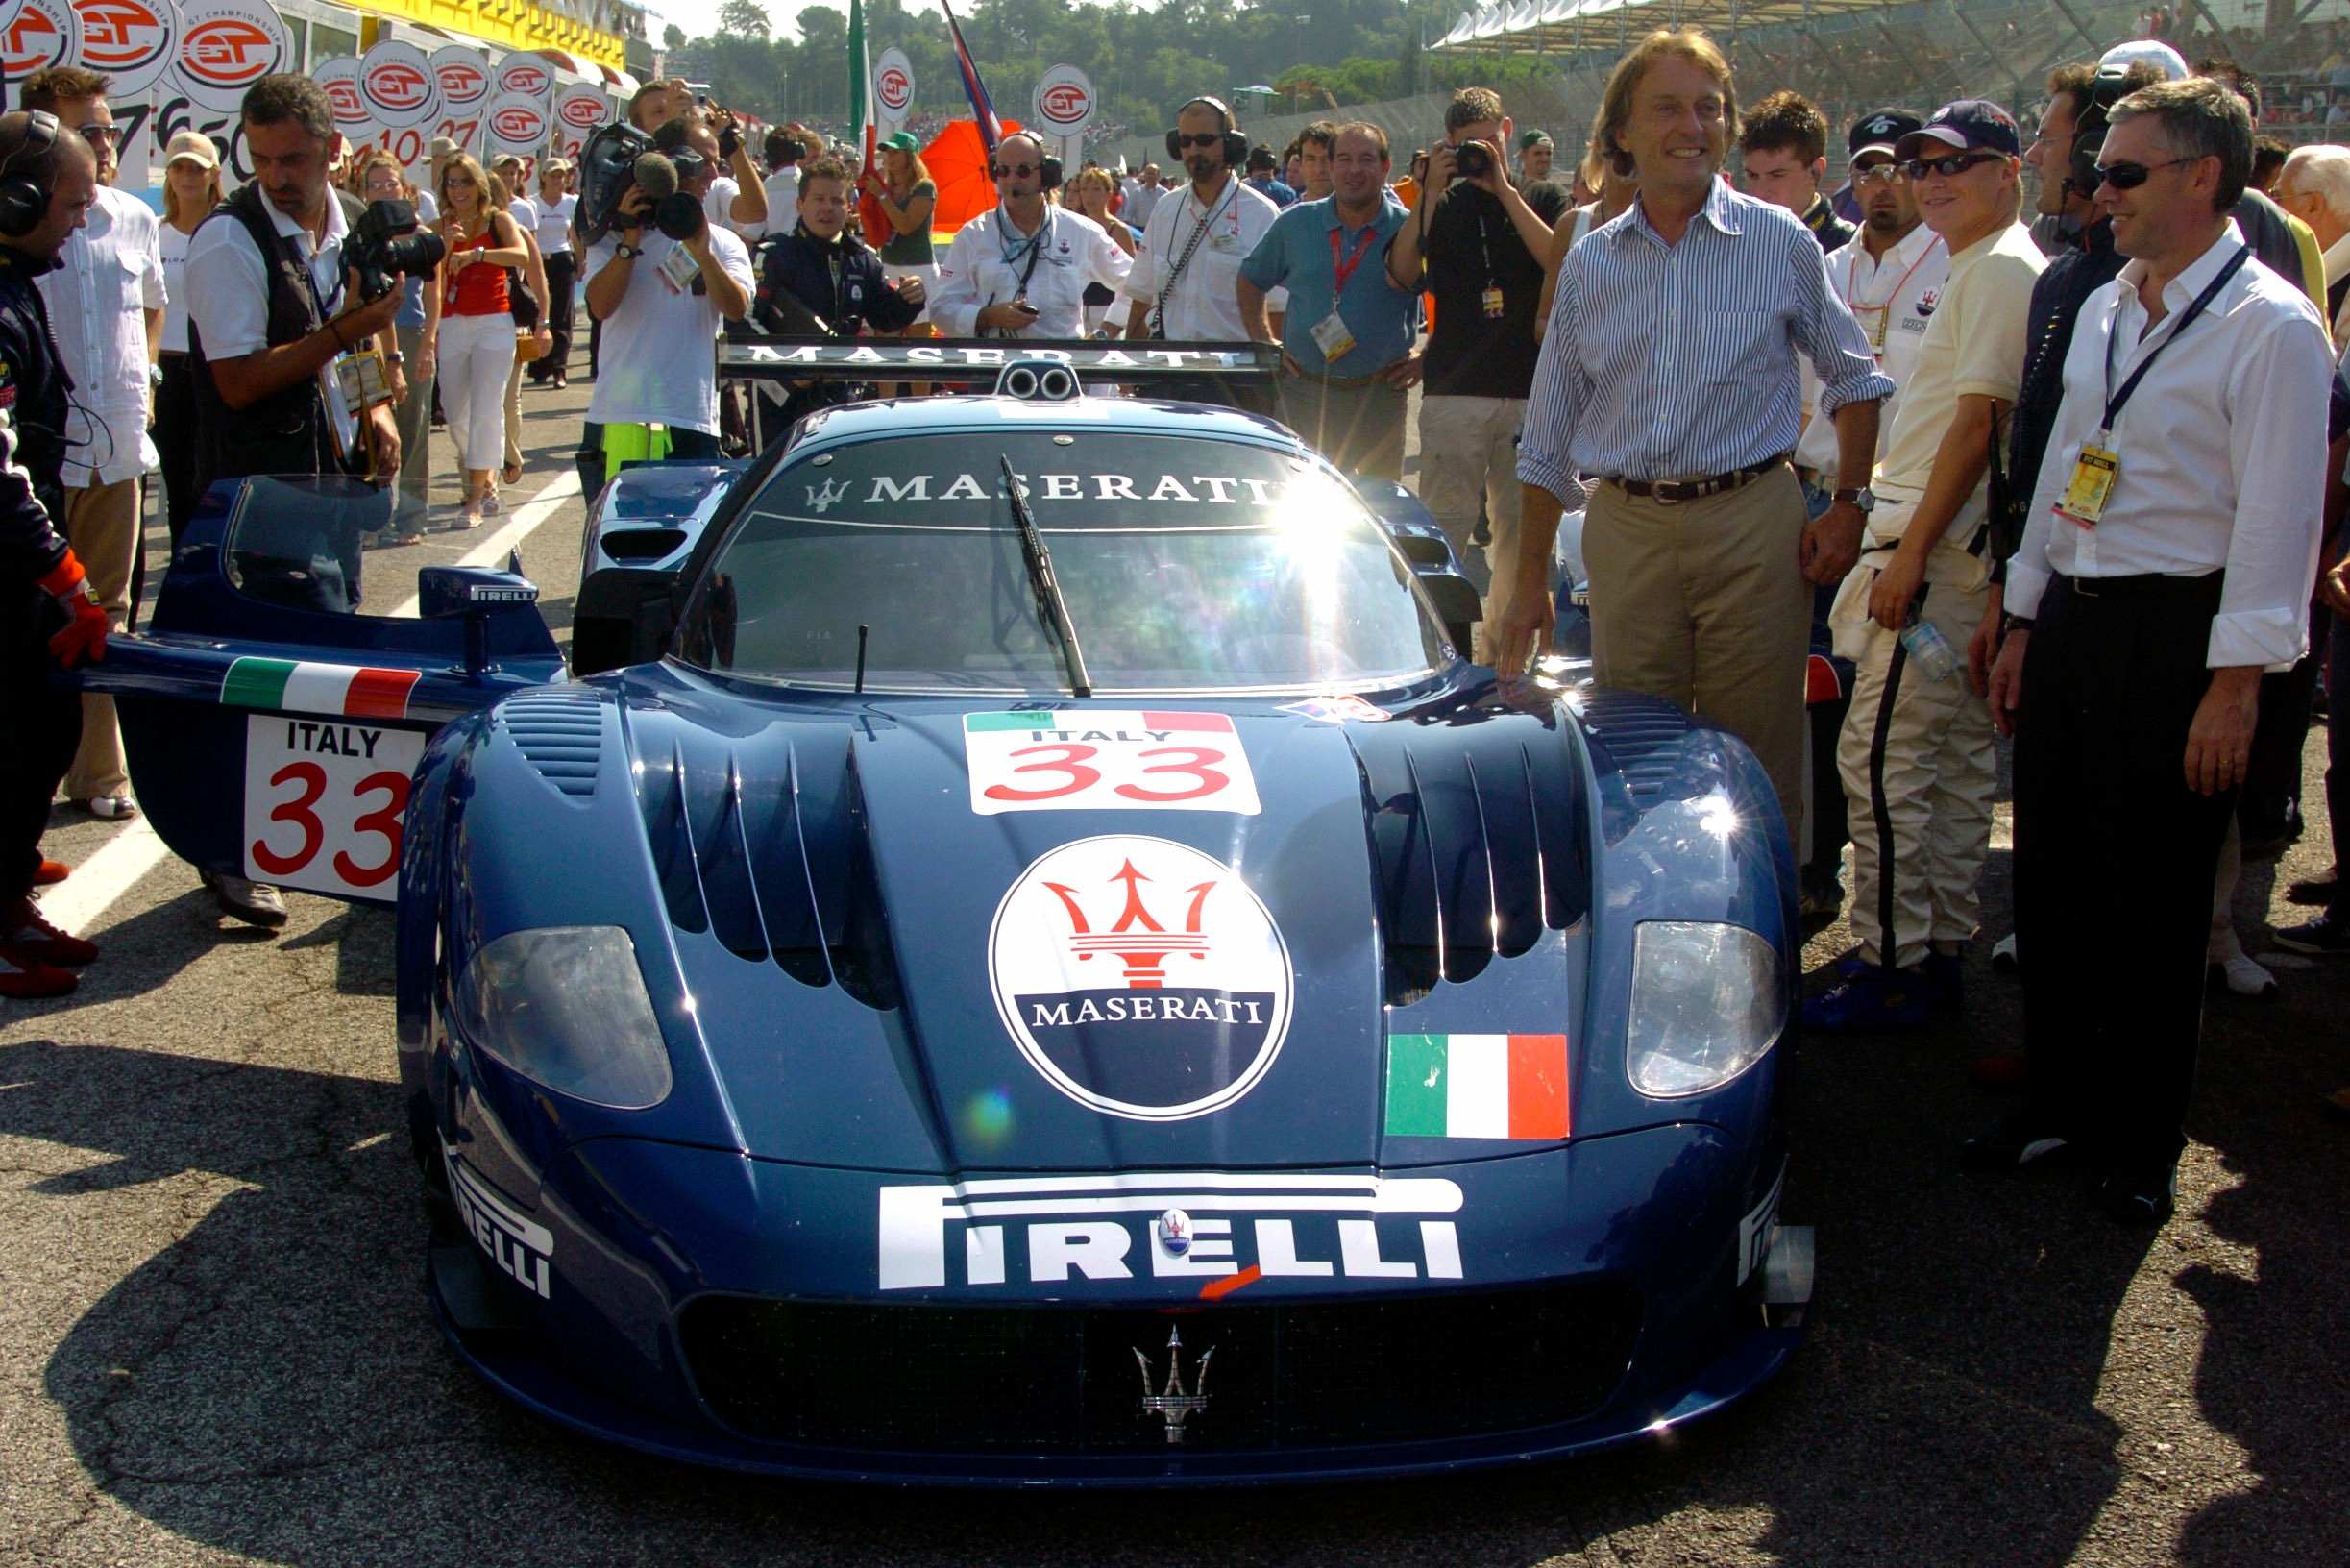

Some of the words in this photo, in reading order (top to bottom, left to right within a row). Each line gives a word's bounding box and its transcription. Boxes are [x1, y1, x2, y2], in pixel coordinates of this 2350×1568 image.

[206, 10, 282, 44] CHAMPIONSHIP
[197, 34, 273, 64] GT
[379, 73, 427, 96] GT
[440, 73, 483, 90] GT
[510, 73, 547, 88] GT
[885, 77, 909, 96] GT
[570, 102, 604, 118] GT
[1050, 92, 1087, 110] GT
[502, 114, 541, 132] GT
[379, 128, 422, 168] 10
[863, 474, 1276, 506] MASERATI
[470, 584, 539, 601] PIRELLI
[807, 629, 831, 640] FIA
[287, 721, 382, 759] ITALY
[1031, 730, 1173, 743] ITALY
[983, 743, 1231, 802] 33
[251, 760, 412, 888] 33
[1031, 995, 1264, 1028] MASERATI
[878, 1172, 1464, 1290] PIRELLI
